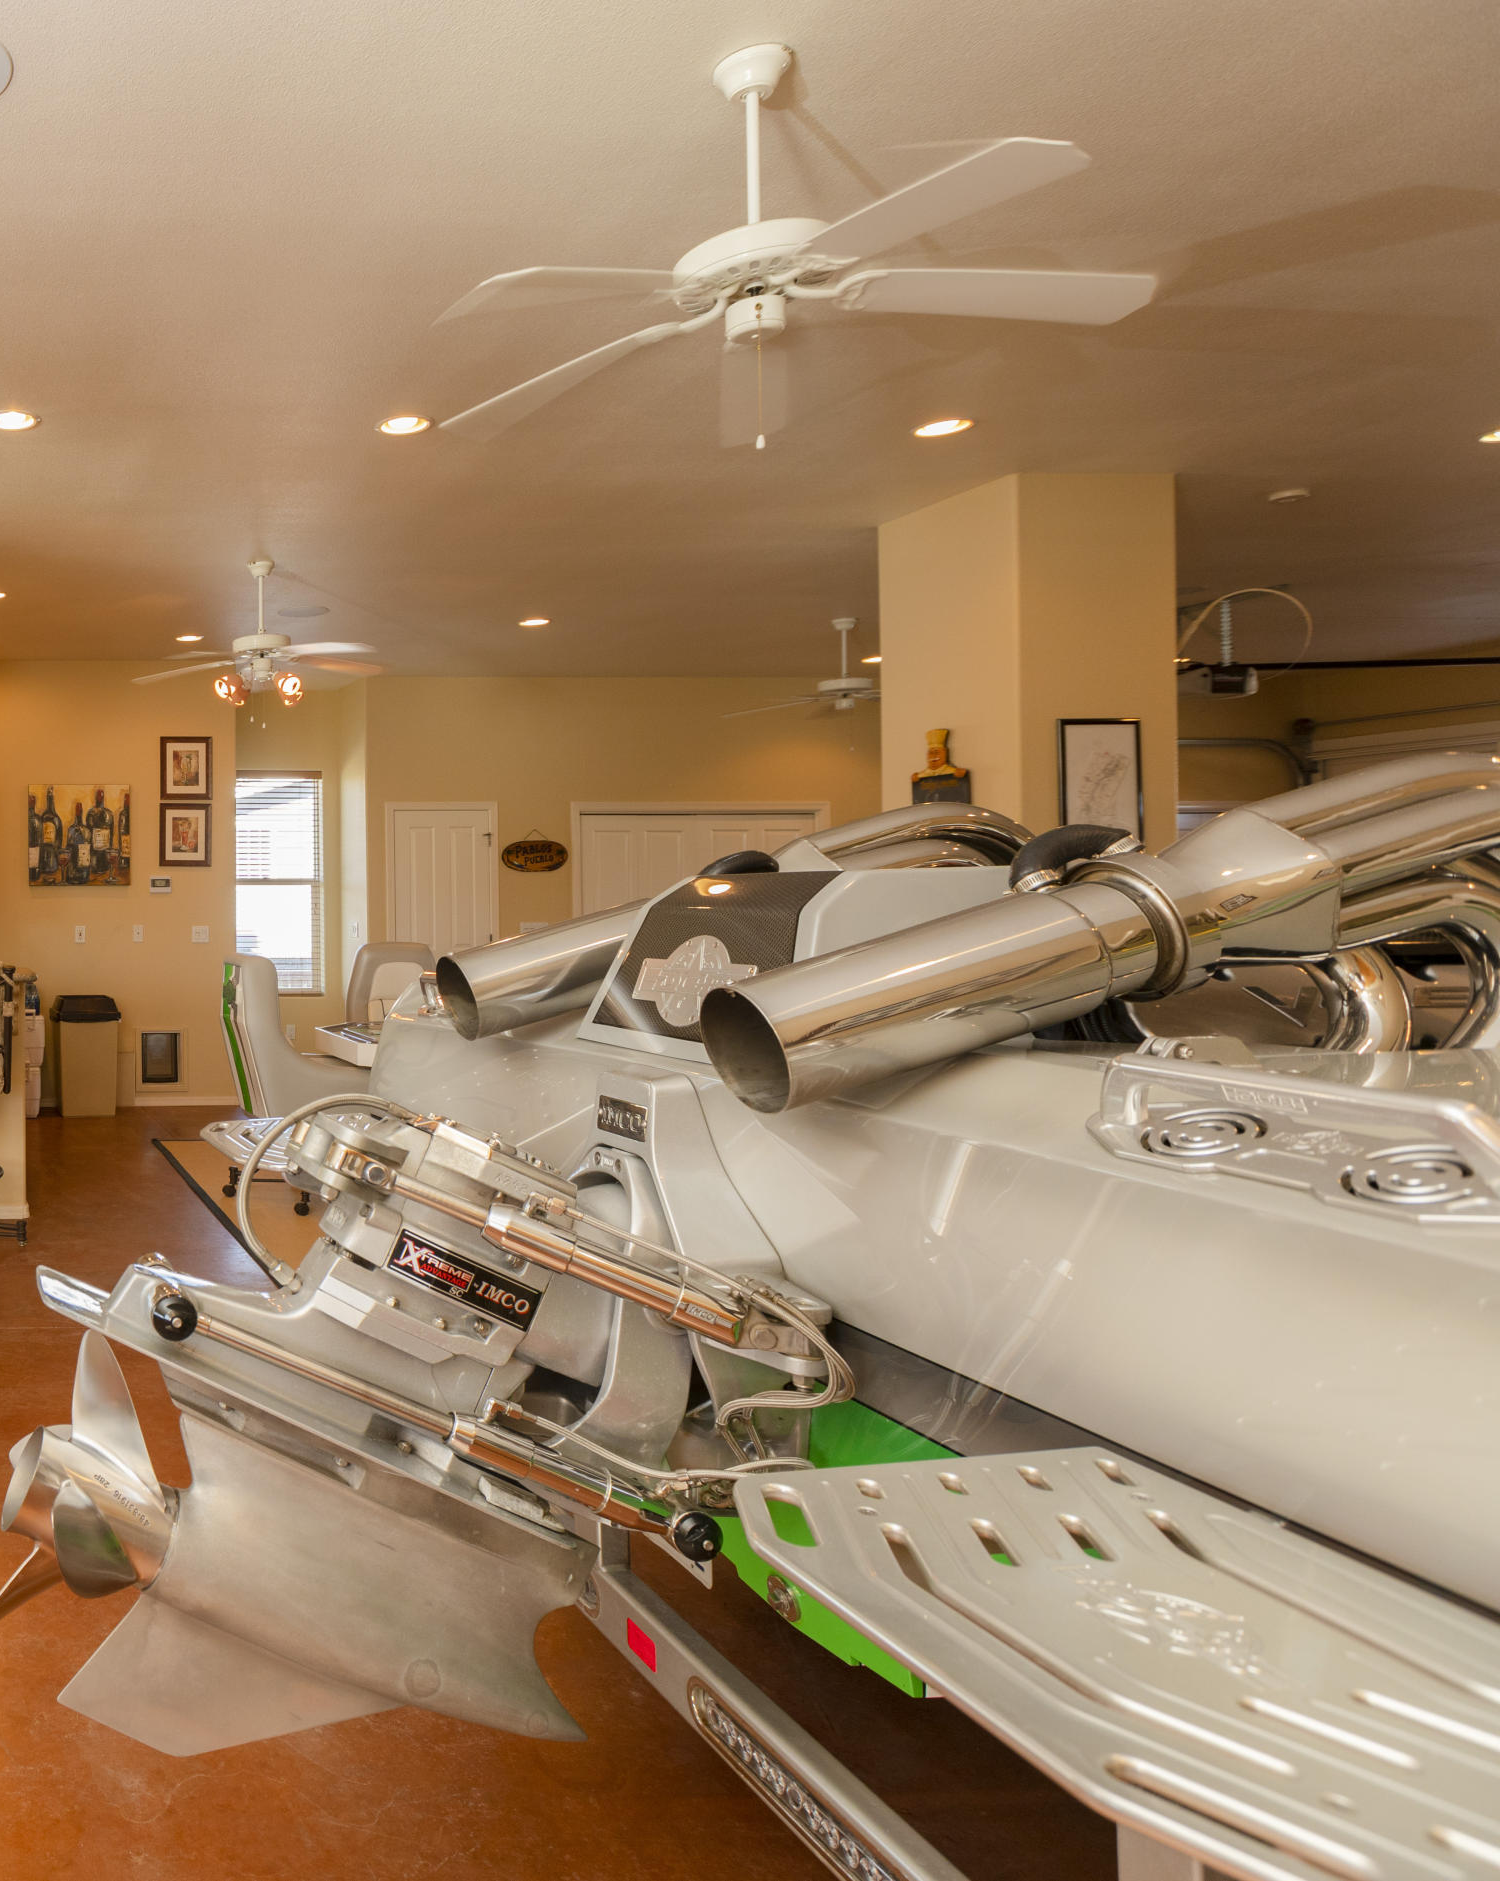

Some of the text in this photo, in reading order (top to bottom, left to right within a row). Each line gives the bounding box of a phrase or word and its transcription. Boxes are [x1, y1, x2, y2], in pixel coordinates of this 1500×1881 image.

[420, 1262, 467, 1288] ADVANTAGE
[449, 1286, 465, 1298] SC
[475, 1280, 530, 1315] IMCO
